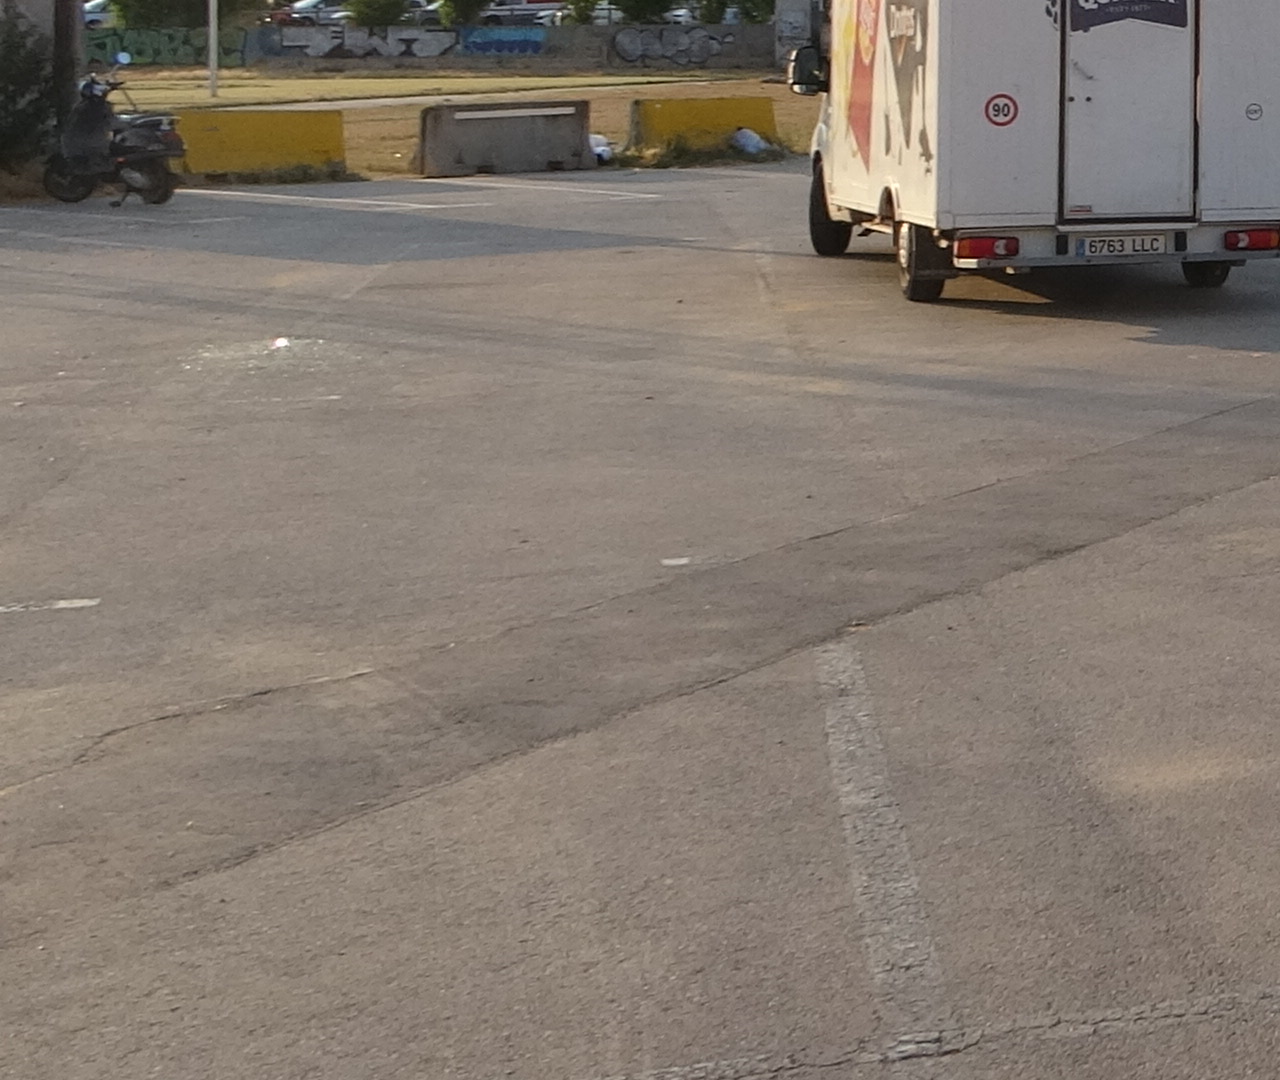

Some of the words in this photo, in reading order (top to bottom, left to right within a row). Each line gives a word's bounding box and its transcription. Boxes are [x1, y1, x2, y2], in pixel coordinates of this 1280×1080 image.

[992, 103, 1010, 118] 90
[1089, 239, 1125, 254] 6763
[1132, 238, 1160, 252] LLC
